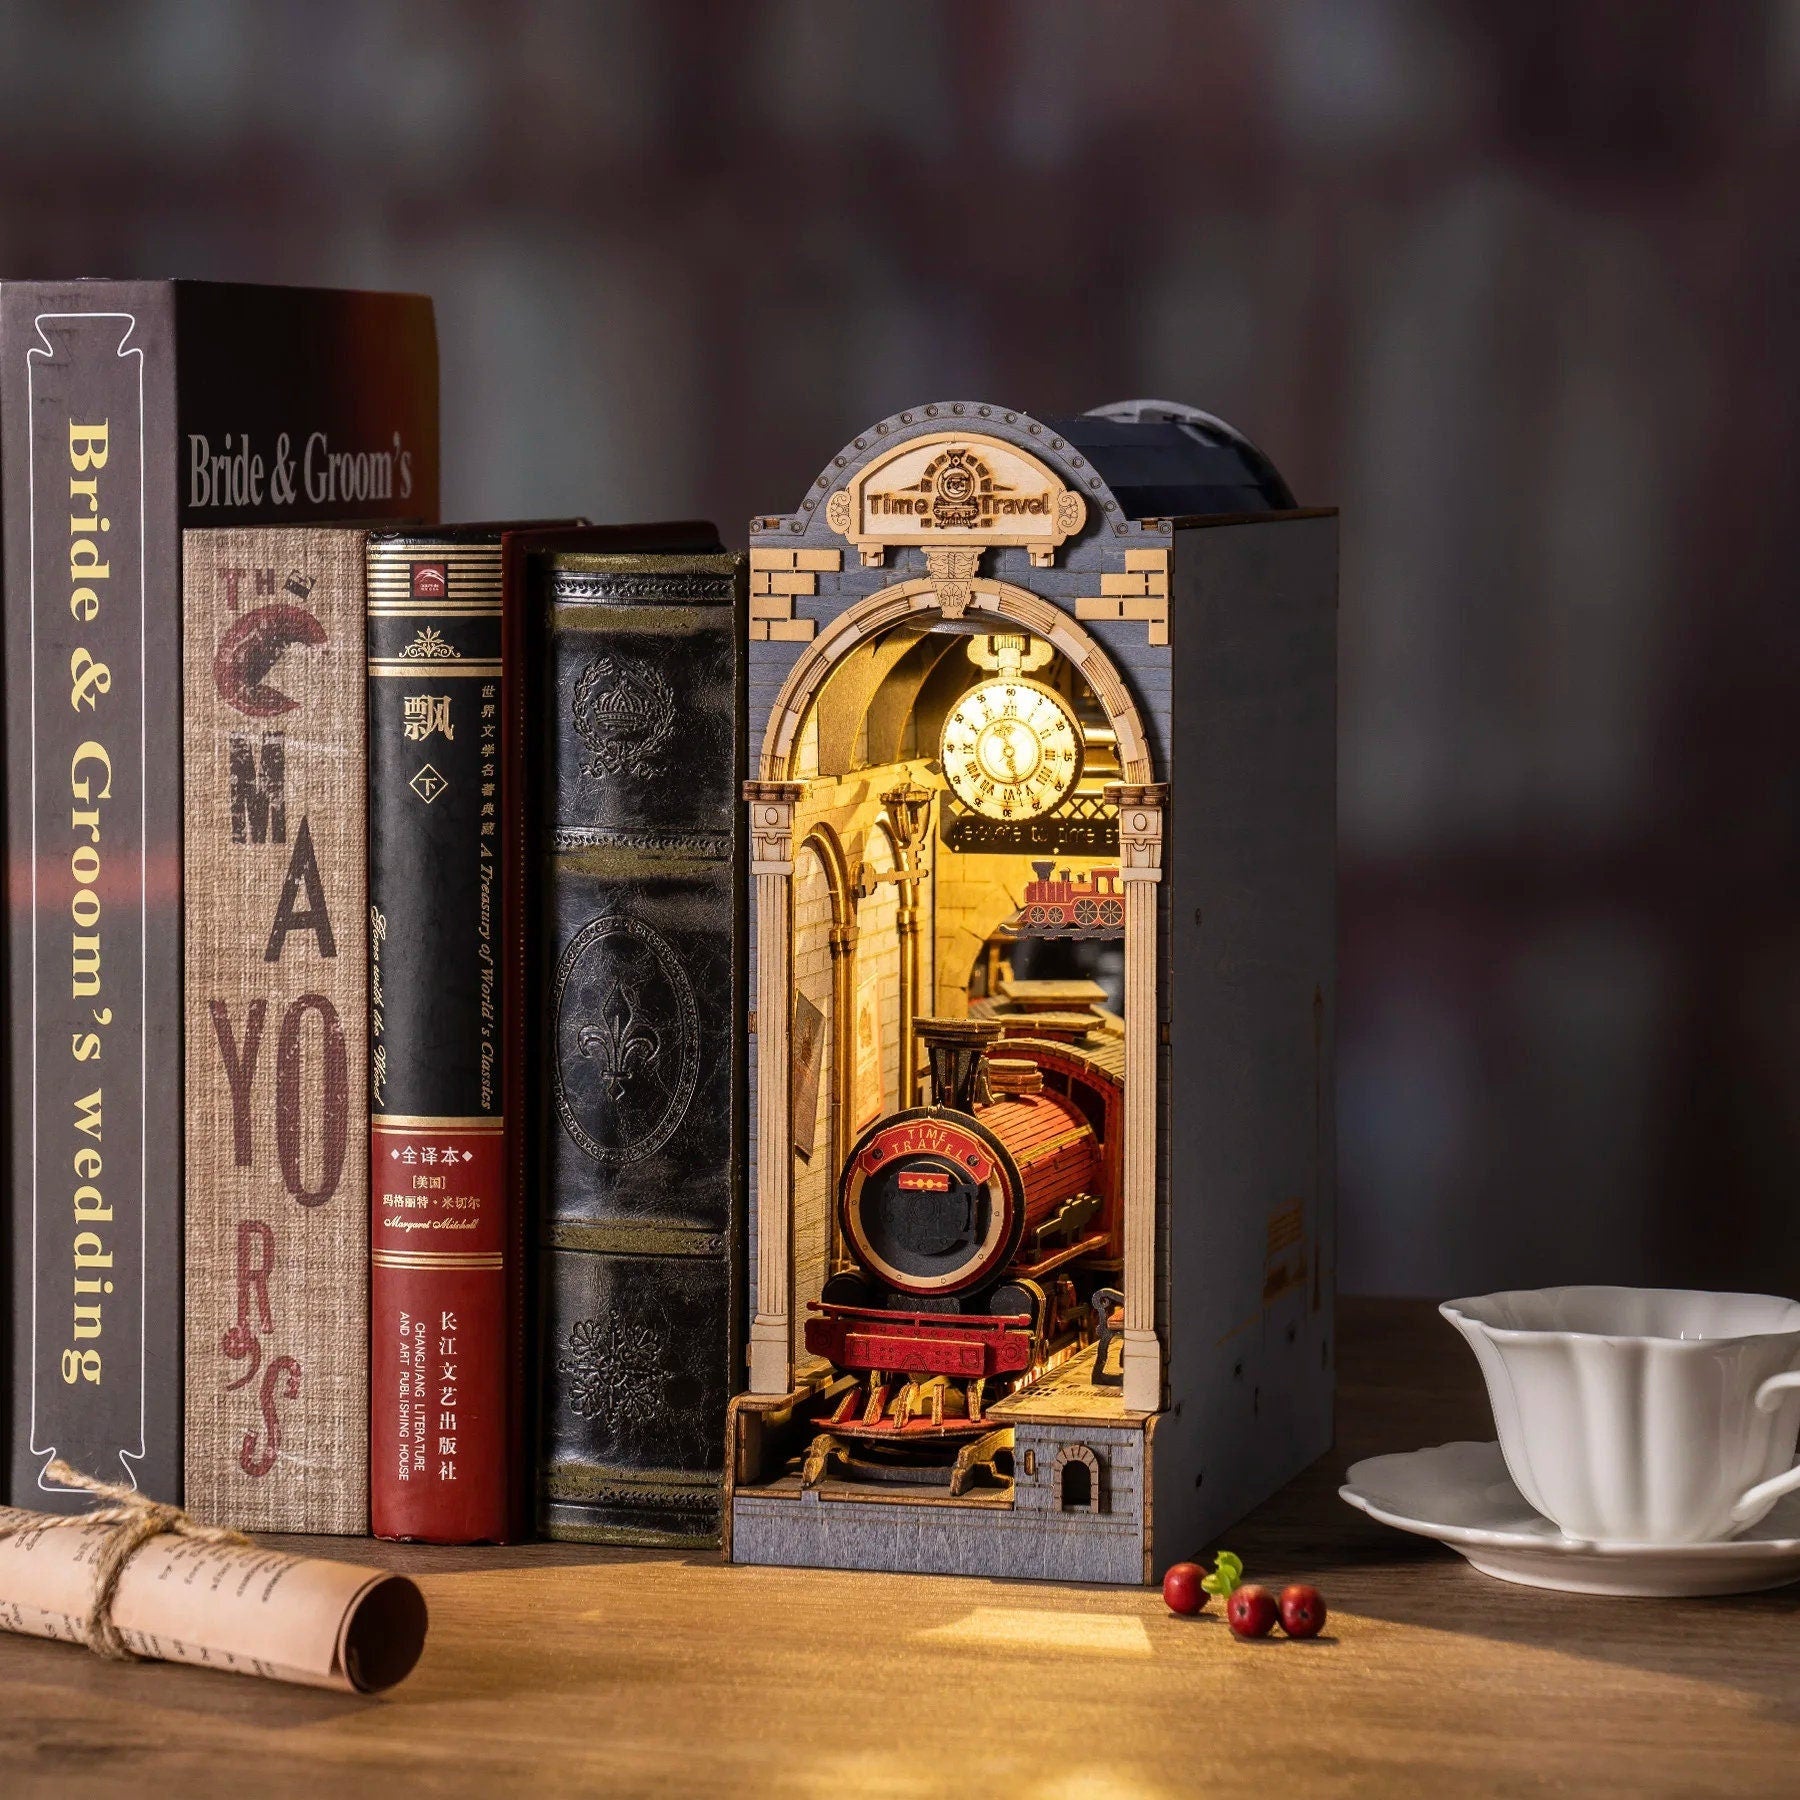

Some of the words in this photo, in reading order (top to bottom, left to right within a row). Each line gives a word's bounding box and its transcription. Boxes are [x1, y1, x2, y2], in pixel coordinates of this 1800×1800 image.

[187, 433, 264, 508] Bride
[270, 431, 299, 504] &
[303, 431, 413, 503] Groom's
[69, 417, 110, 622] Bride
[867, 493, 928, 515] Time
[978, 492, 1050, 515] Travel
[217, 567, 317, 611] THE
[70, 647, 111, 712] &
[1006, 688, 1016, 697] 60
[403, 694, 454, 741] 飘
[419, 777, 437, 795] 下
[480, 842, 494, 858] A
[71, 741, 113, 1062] Groom's
[478, 864, 494, 941] Treasury
[371, 906, 387, 961] Gone
[479, 943, 494, 965] of
[373, 965, 385, 1008] with
[480, 967, 494, 1037] World's
[373, 1009, 385, 1036] the
[373, 1045, 387, 1107] Wind
[480, 1041, 495, 1110] Classics
[401, 1145, 459, 1166] 全译本
[892, 1138, 963, 1160] TRAVEL
[907, 1128, 947, 1142] TIME
[61, 1088, 114, 1385] wedding
[383, 1215, 430, 1233] Margaret
[432, 1217, 480, 1230] Mitchell
[399, 1311, 410, 1336] AND
[399, 1342, 410, 1366] ART
[414, 1322, 425, 1397] CHANGJIANG
[399, 1371, 410, 1438] PUBLISHING
[438, 1311, 458, 1481] 长江文艺出版社
[414, 1403, 425, 1472] LITERATURE
[399, 1443, 409, 1481] HOUSE
